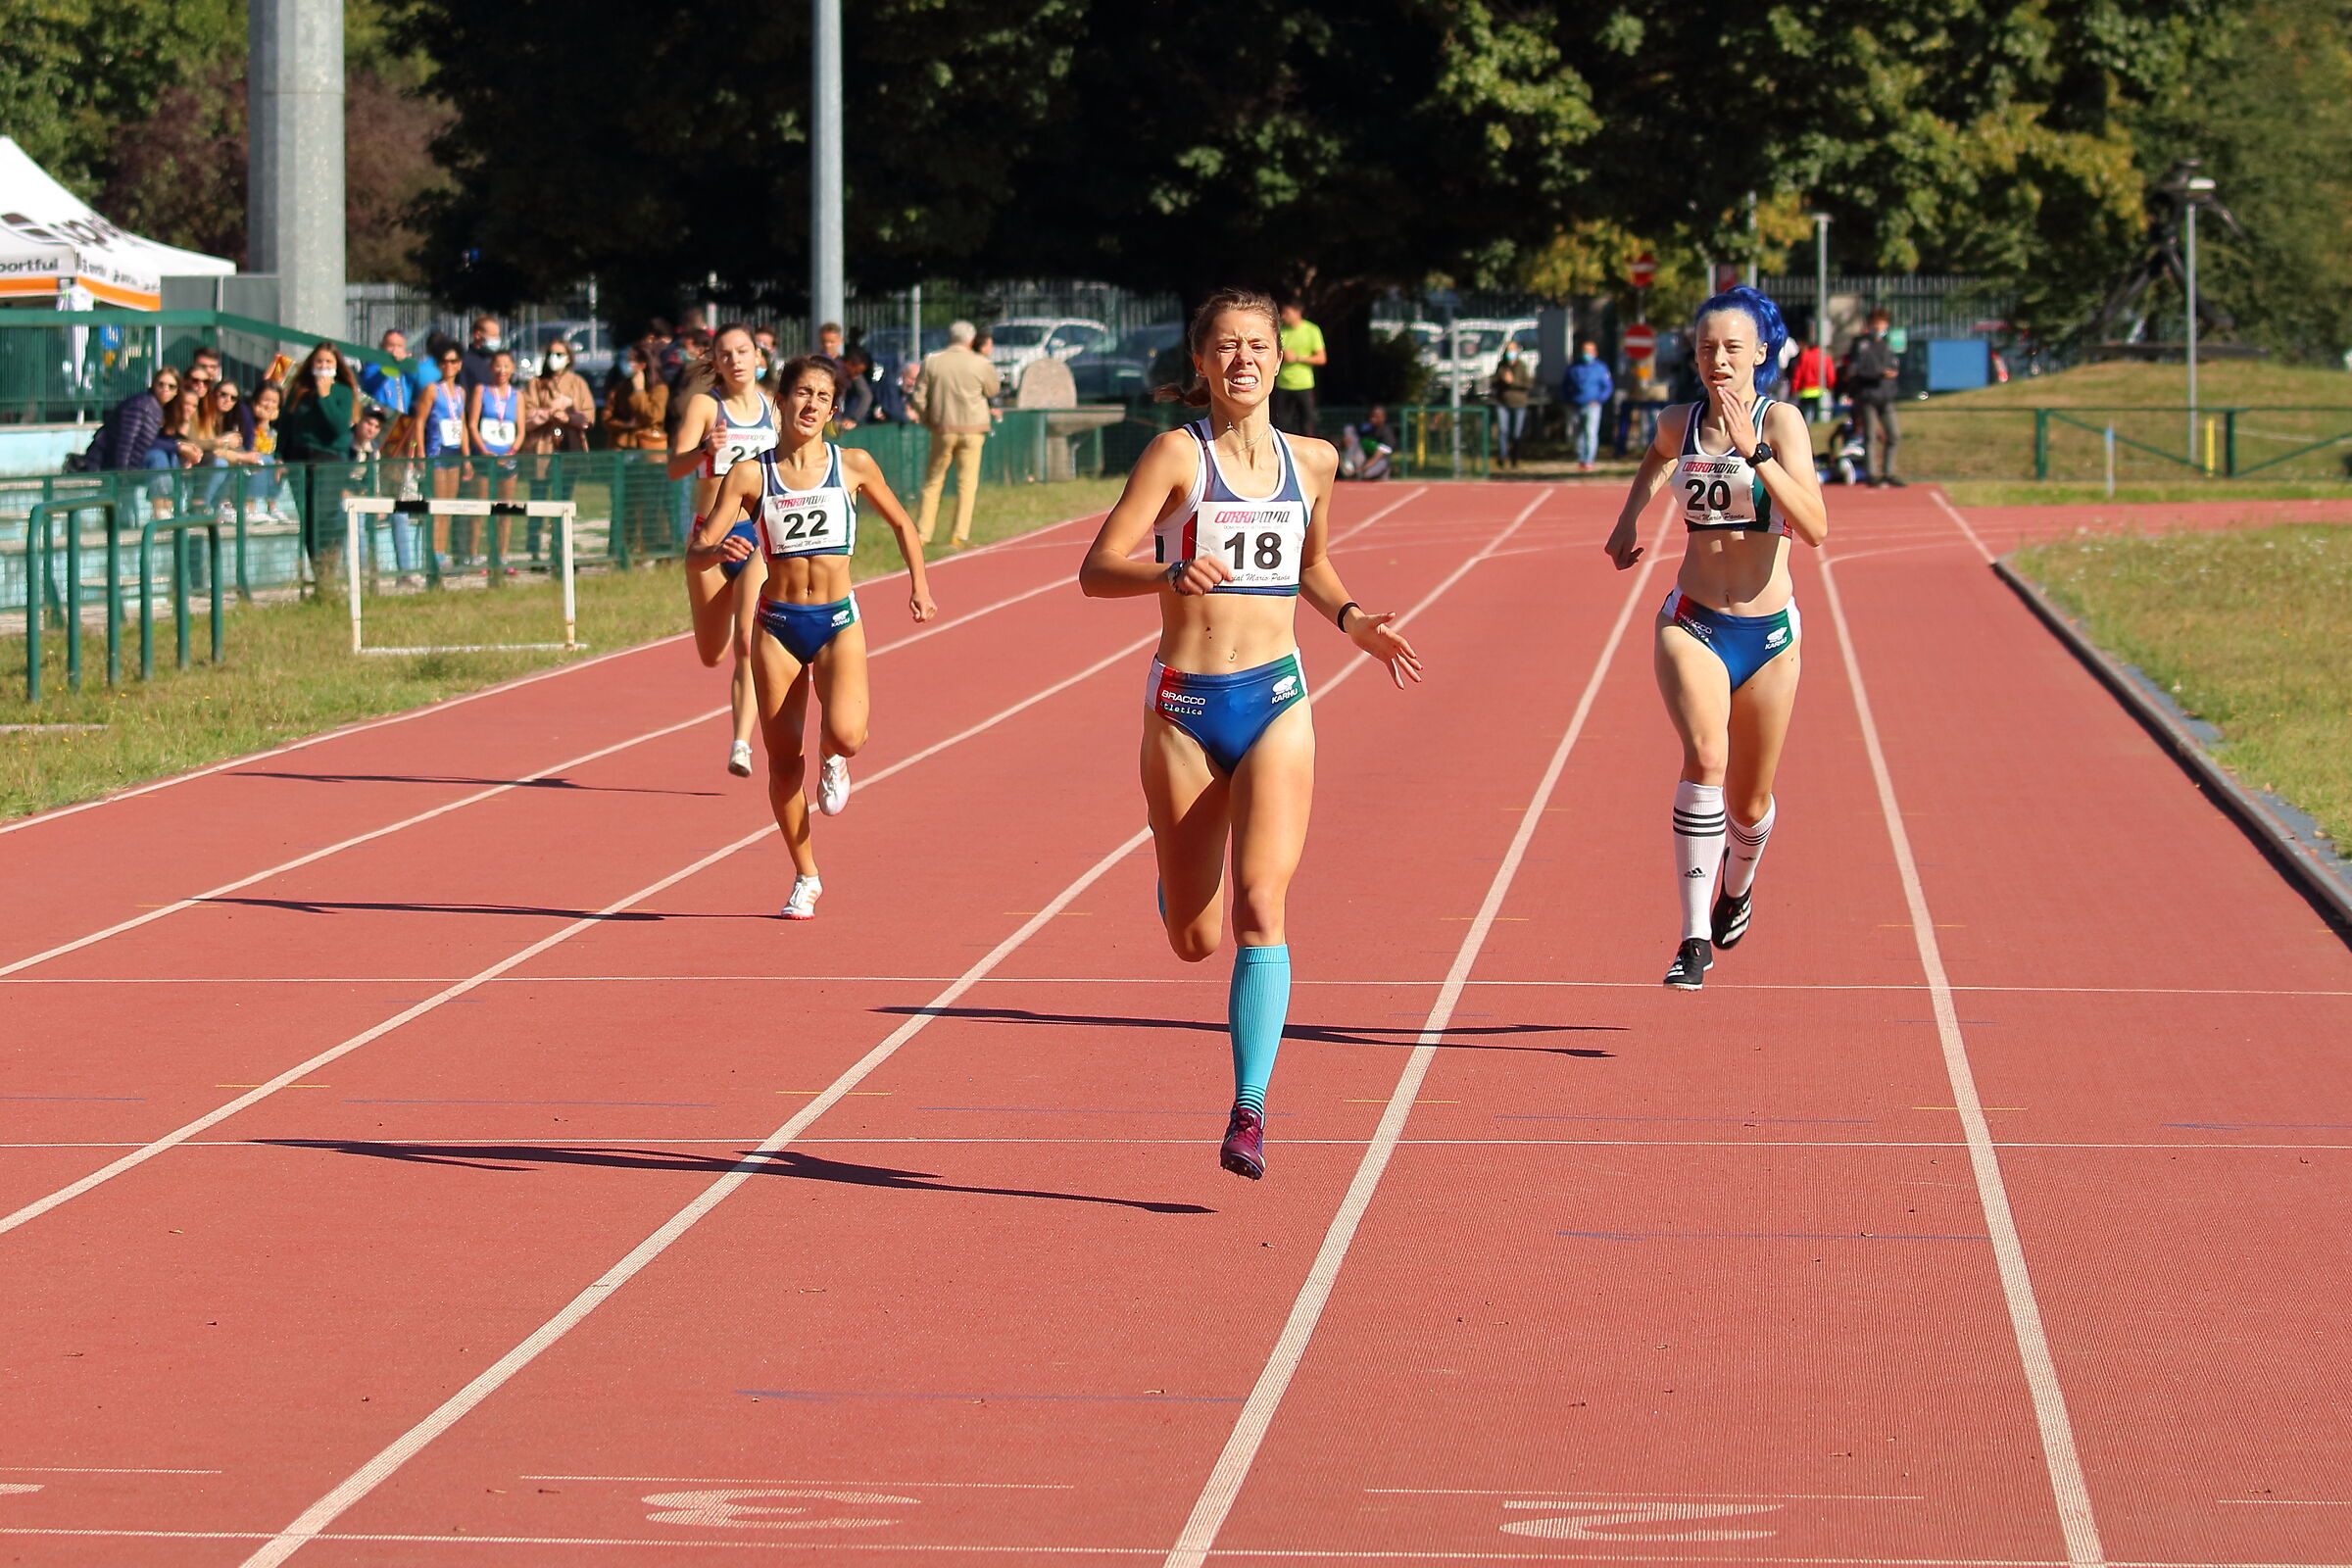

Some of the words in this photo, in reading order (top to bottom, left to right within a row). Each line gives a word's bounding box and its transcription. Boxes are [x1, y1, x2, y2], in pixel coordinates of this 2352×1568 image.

[1685, 479, 1731, 511] 20
[783, 510, 829, 540] 22
[1224, 532, 1282, 569] 18
[1161, 689, 1205, 706] BRACCO
[1271, 688, 1298, 704] KARHU
